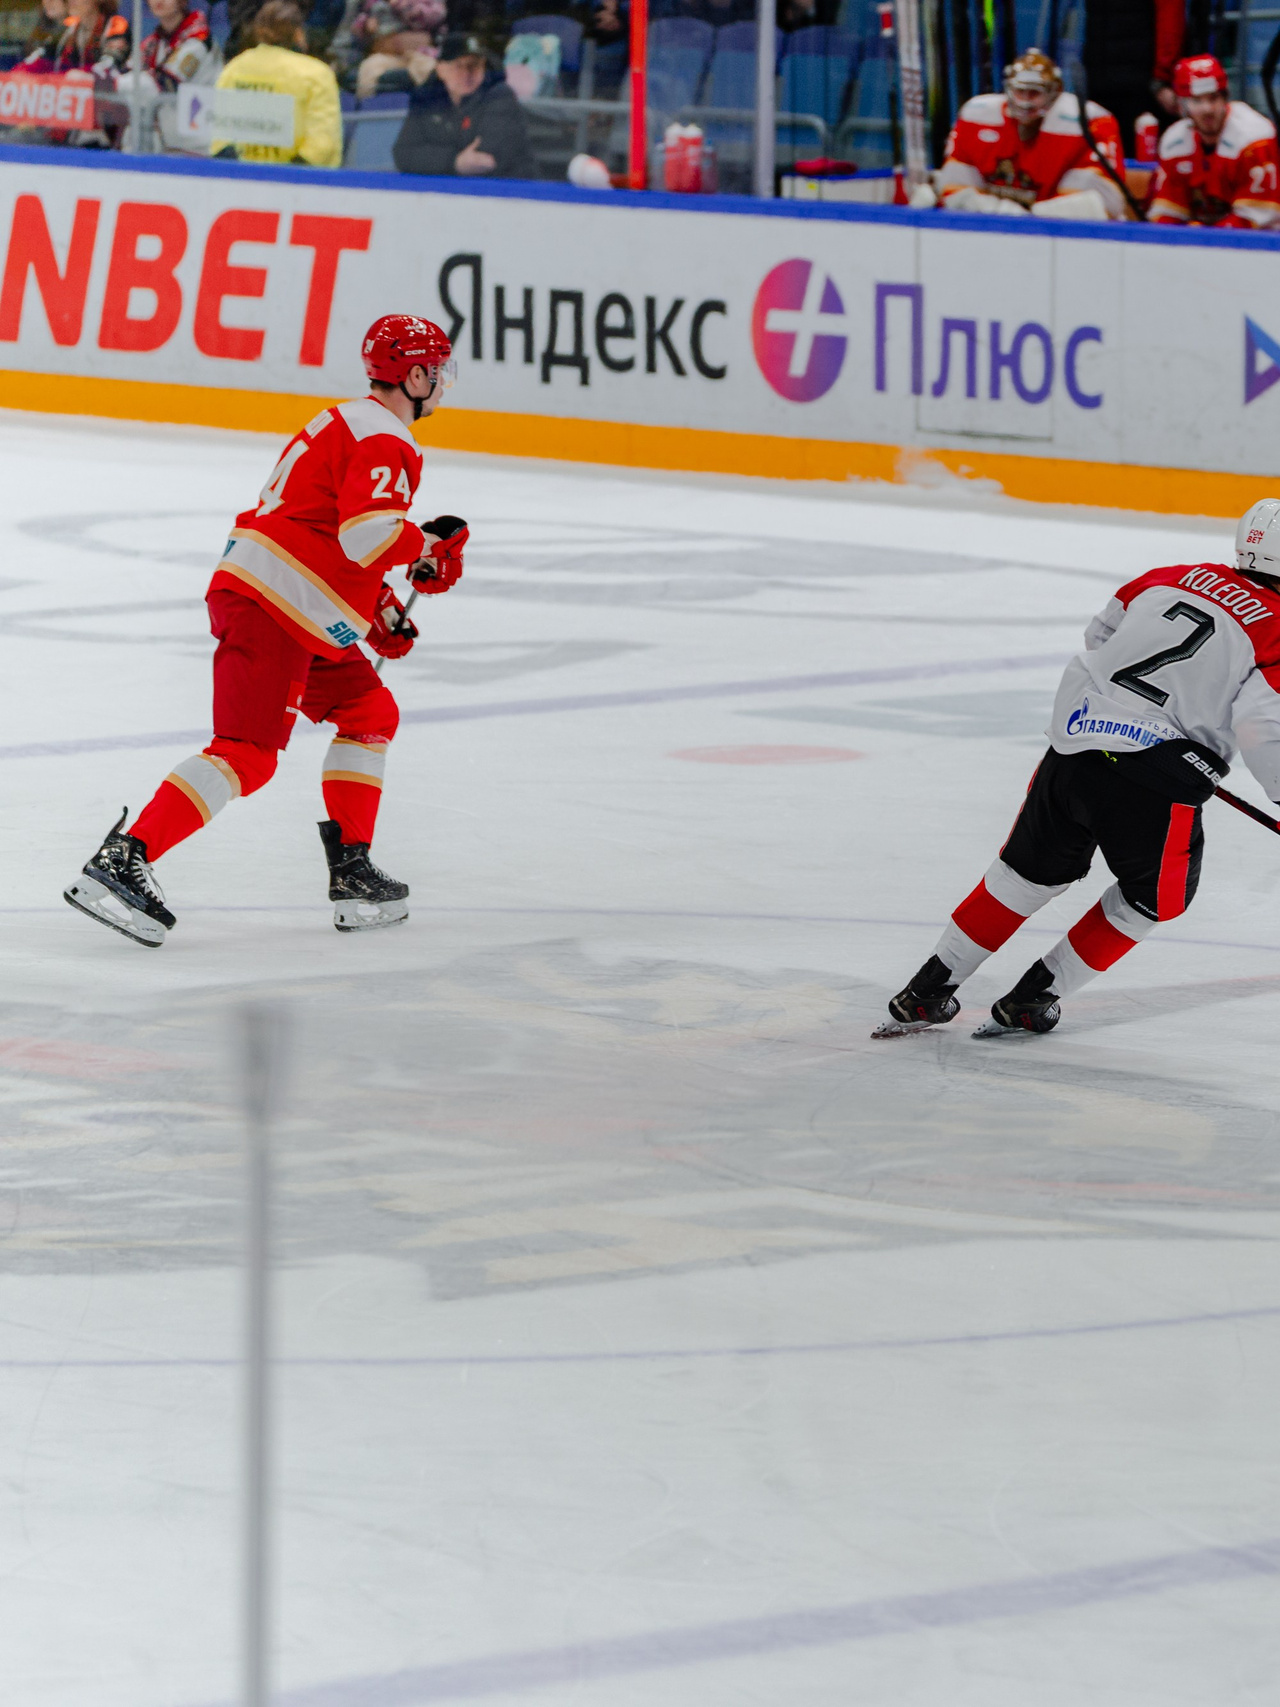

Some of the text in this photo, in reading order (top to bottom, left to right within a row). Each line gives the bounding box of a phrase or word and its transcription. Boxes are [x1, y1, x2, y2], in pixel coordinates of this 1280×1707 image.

[0, 193, 373, 367] NBET
[438, 252, 1105, 410] Яндекс Плюс
[370, 465, 412, 503] 24
[1246, 536, 1262, 545] BET
[1247, 551, 1256, 569] 2
[1178, 566, 1275, 626] KOLEDOV
[325, 620, 361, 646] SIB
[1110, 600, 1216, 708] 2
